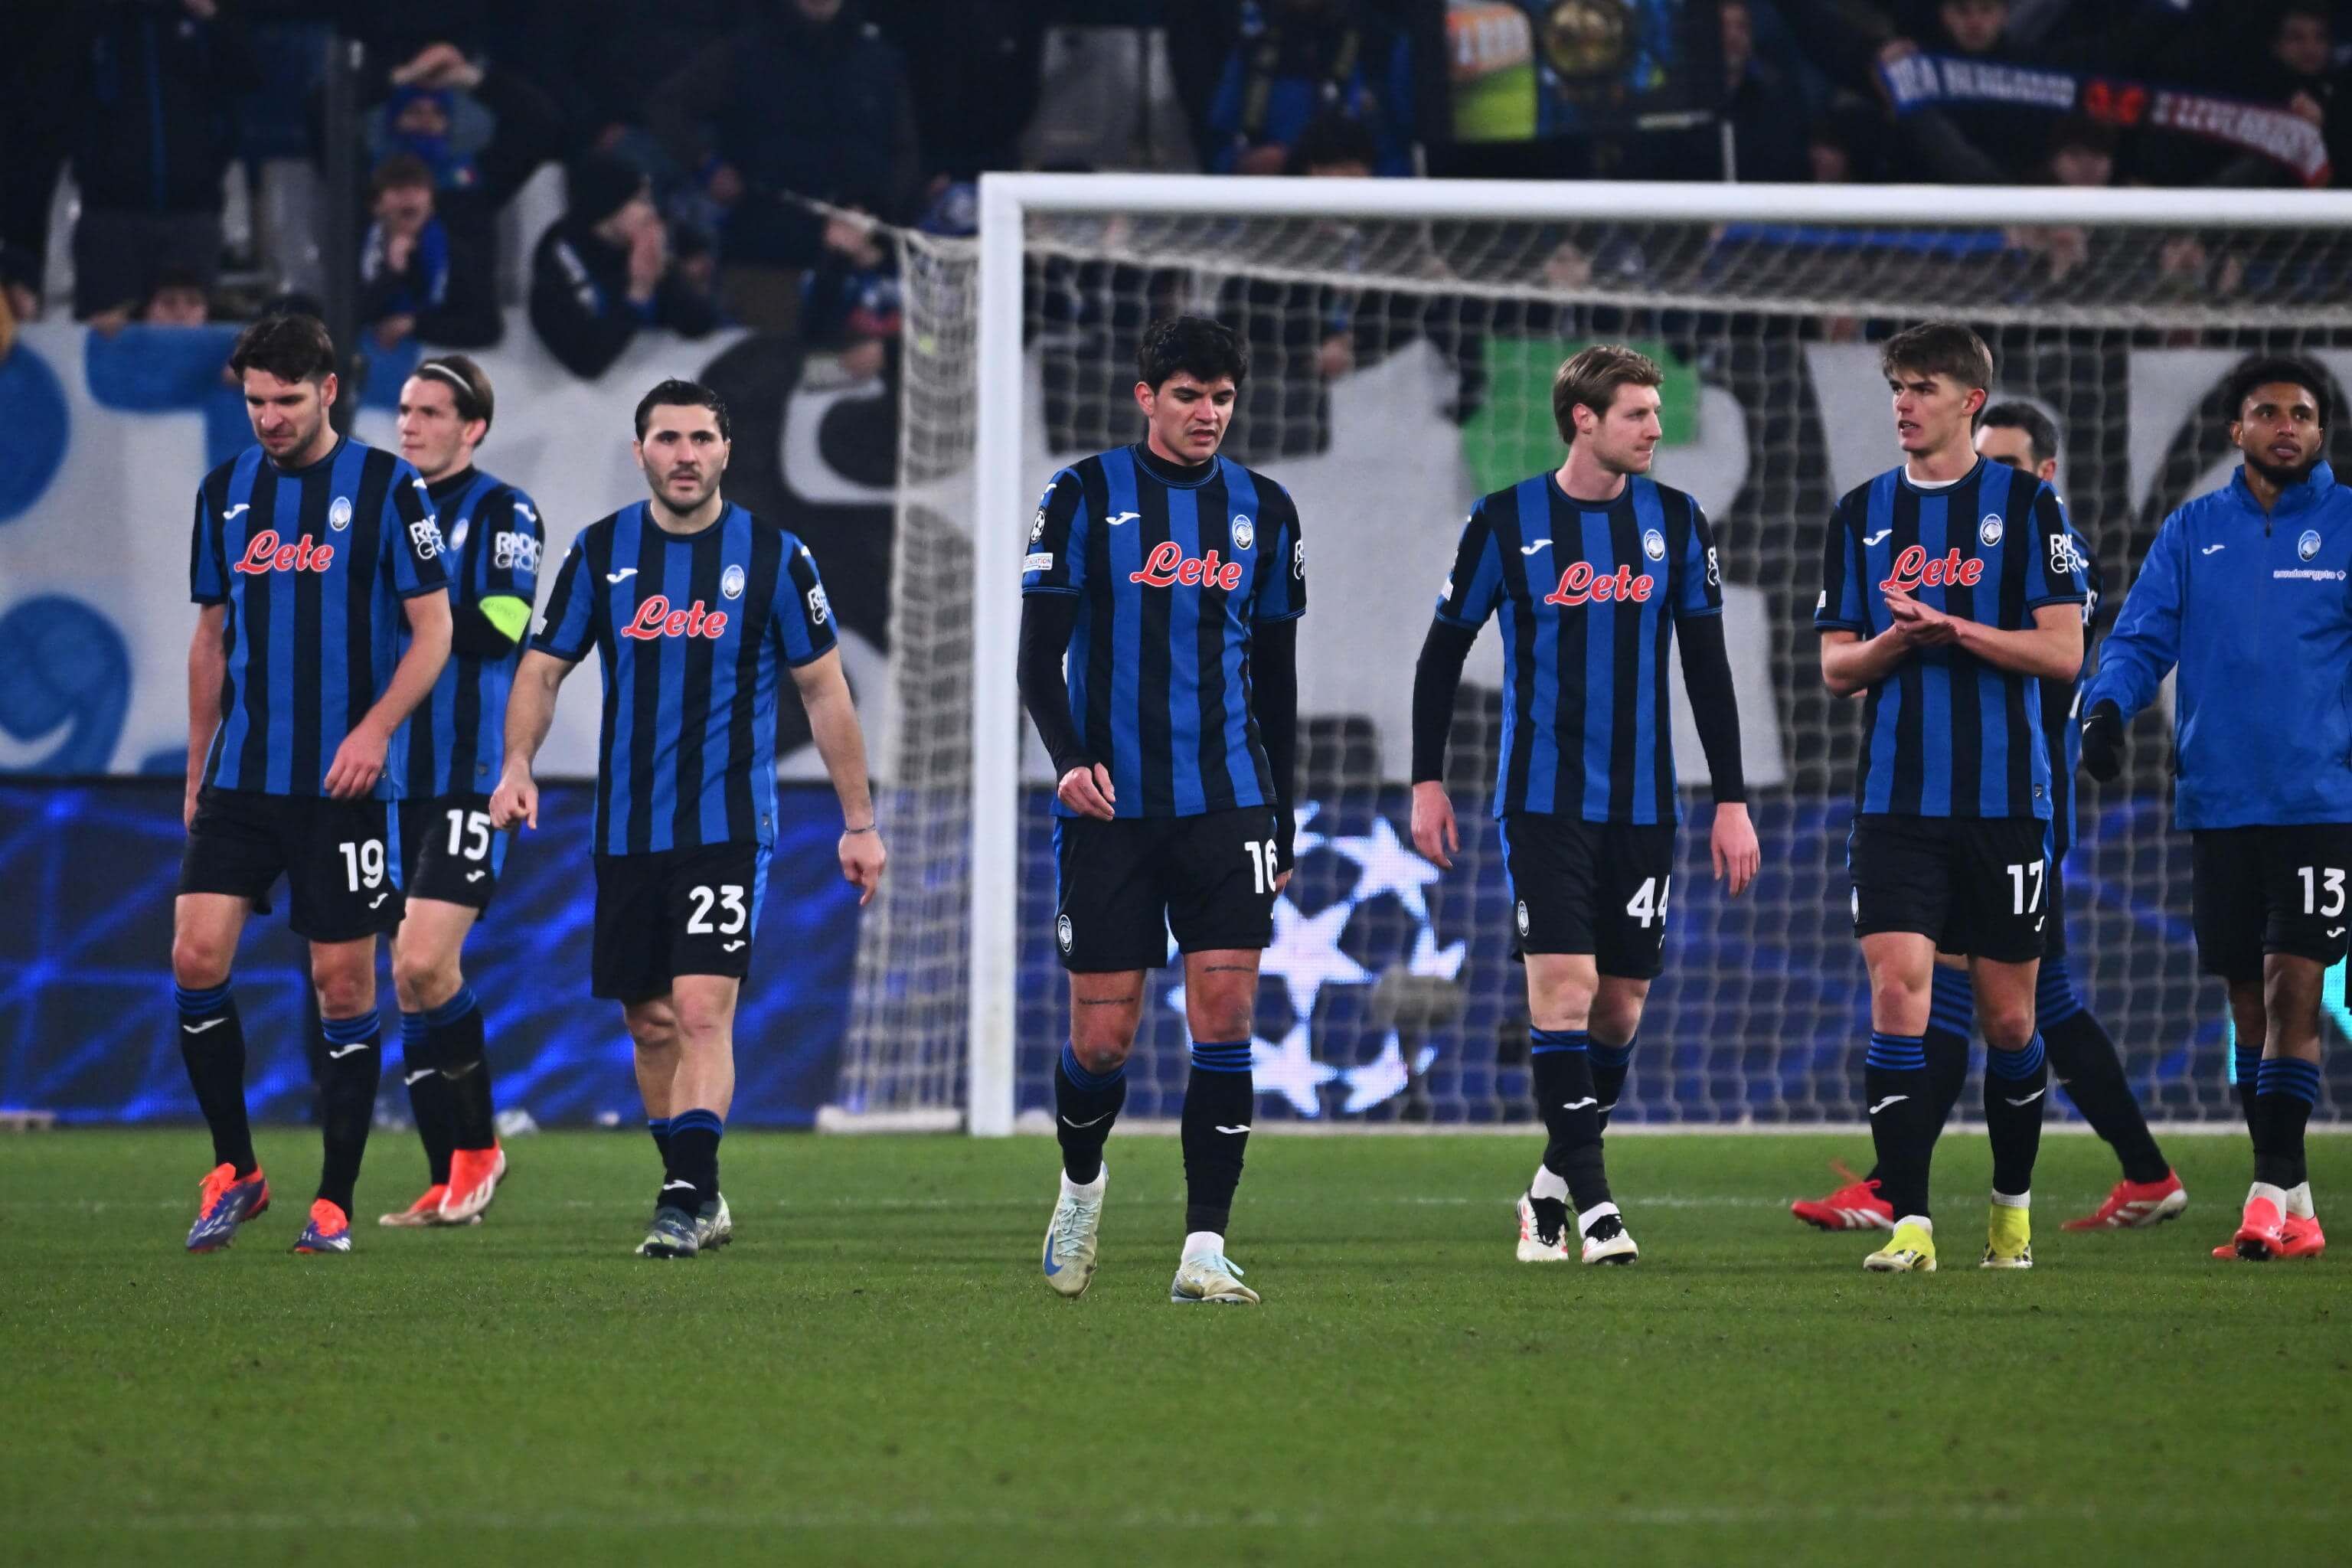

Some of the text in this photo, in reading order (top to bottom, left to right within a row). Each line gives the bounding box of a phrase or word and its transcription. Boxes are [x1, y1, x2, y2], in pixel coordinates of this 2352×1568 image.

[234, 529, 334, 575] Lete
[1129, 541, 1242, 590] Lete
[1879, 545, 1984, 592] Lete
[1544, 561, 1654, 606] Lete
[621, 595, 727, 640] Lete
[446, 808, 491, 861] 15
[339, 838, 384, 892] 19
[2007, 858, 2044, 915] 17
[687, 884, 746, 935] 23
[2298, 866, 2346, 917] 13
